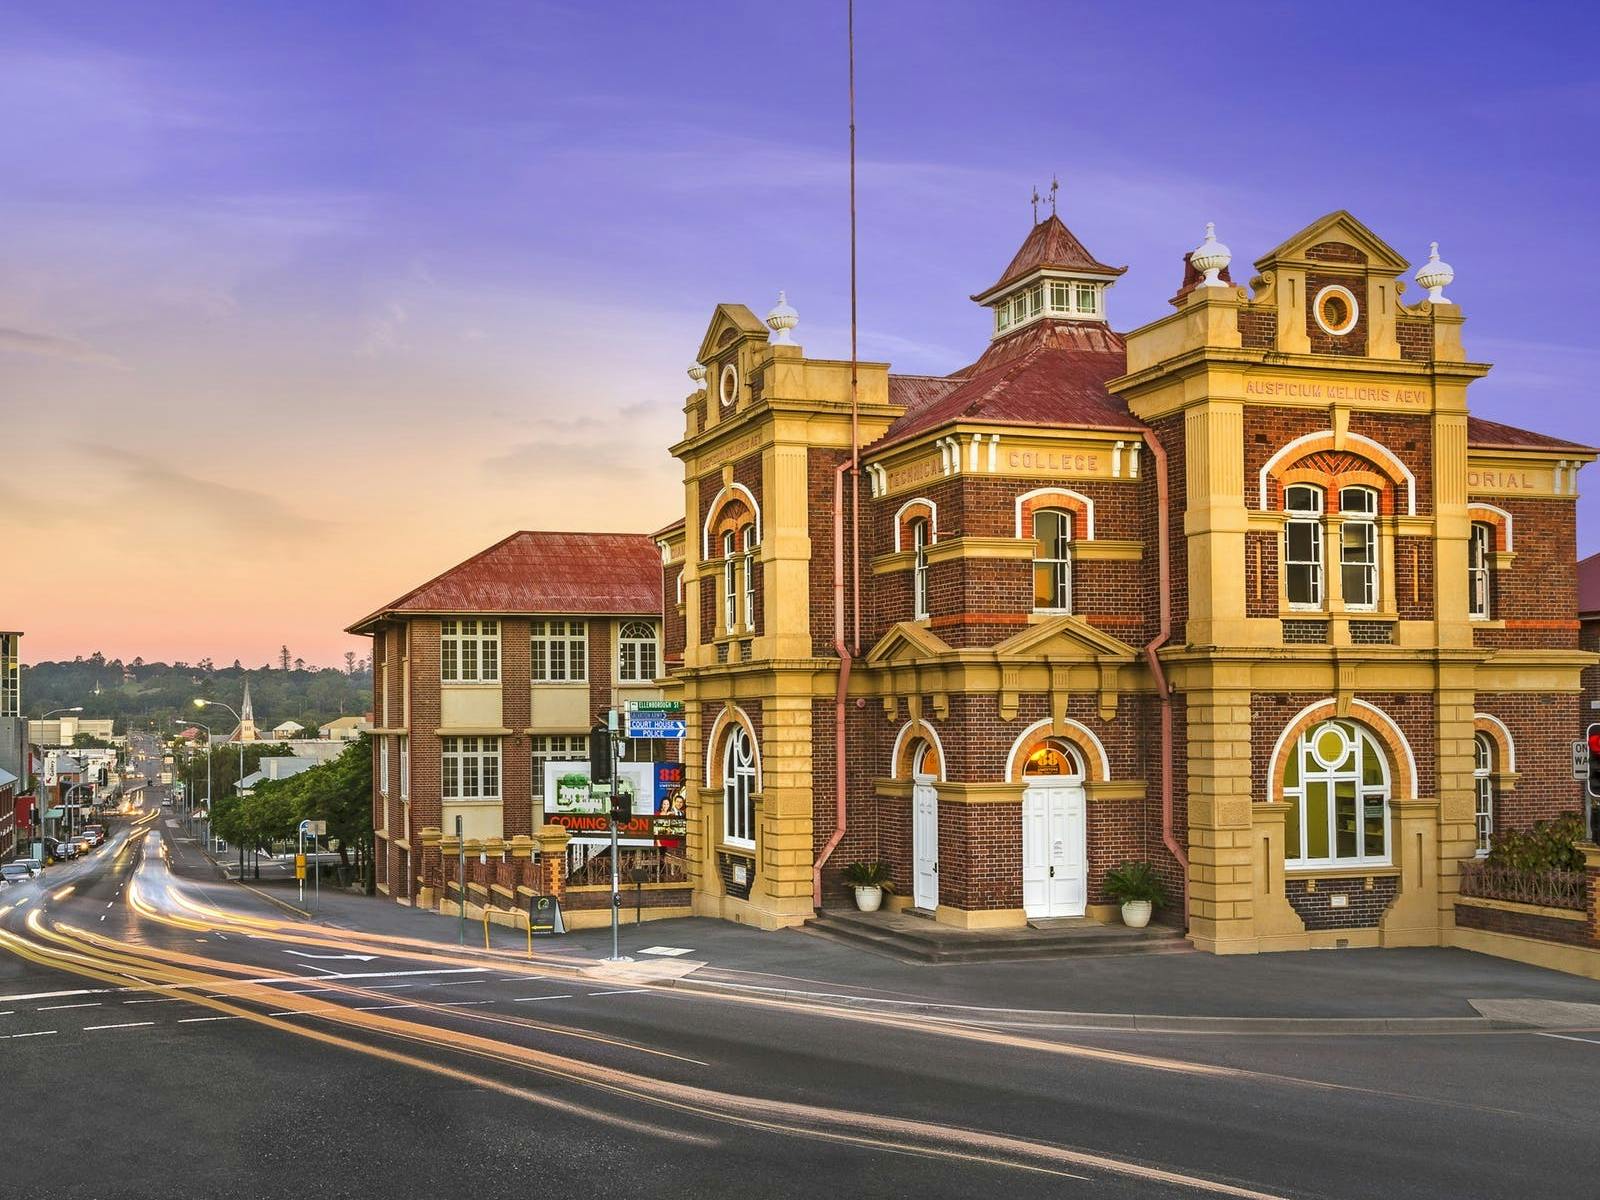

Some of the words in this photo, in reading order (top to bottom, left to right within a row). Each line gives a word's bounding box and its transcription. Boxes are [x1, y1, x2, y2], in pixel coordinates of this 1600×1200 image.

[1246, 381, 1321, 397] AUSPICIUM
[1327, 387, 1392, 401] MELIORIS
[1395, 390, 1428, 403] AEVI
[888, 455, 944, 492] TECHNICAL
[1008, 452, 1099, 471] COLLEGE
[1467, 472, 1535, 488] ORIAL
[1575, 744, 1588, 753] ON
[1575, 756, 1588, 765] WA
[659, 768, 681, 781] 88
[550, 816, 607, 830] COMING
